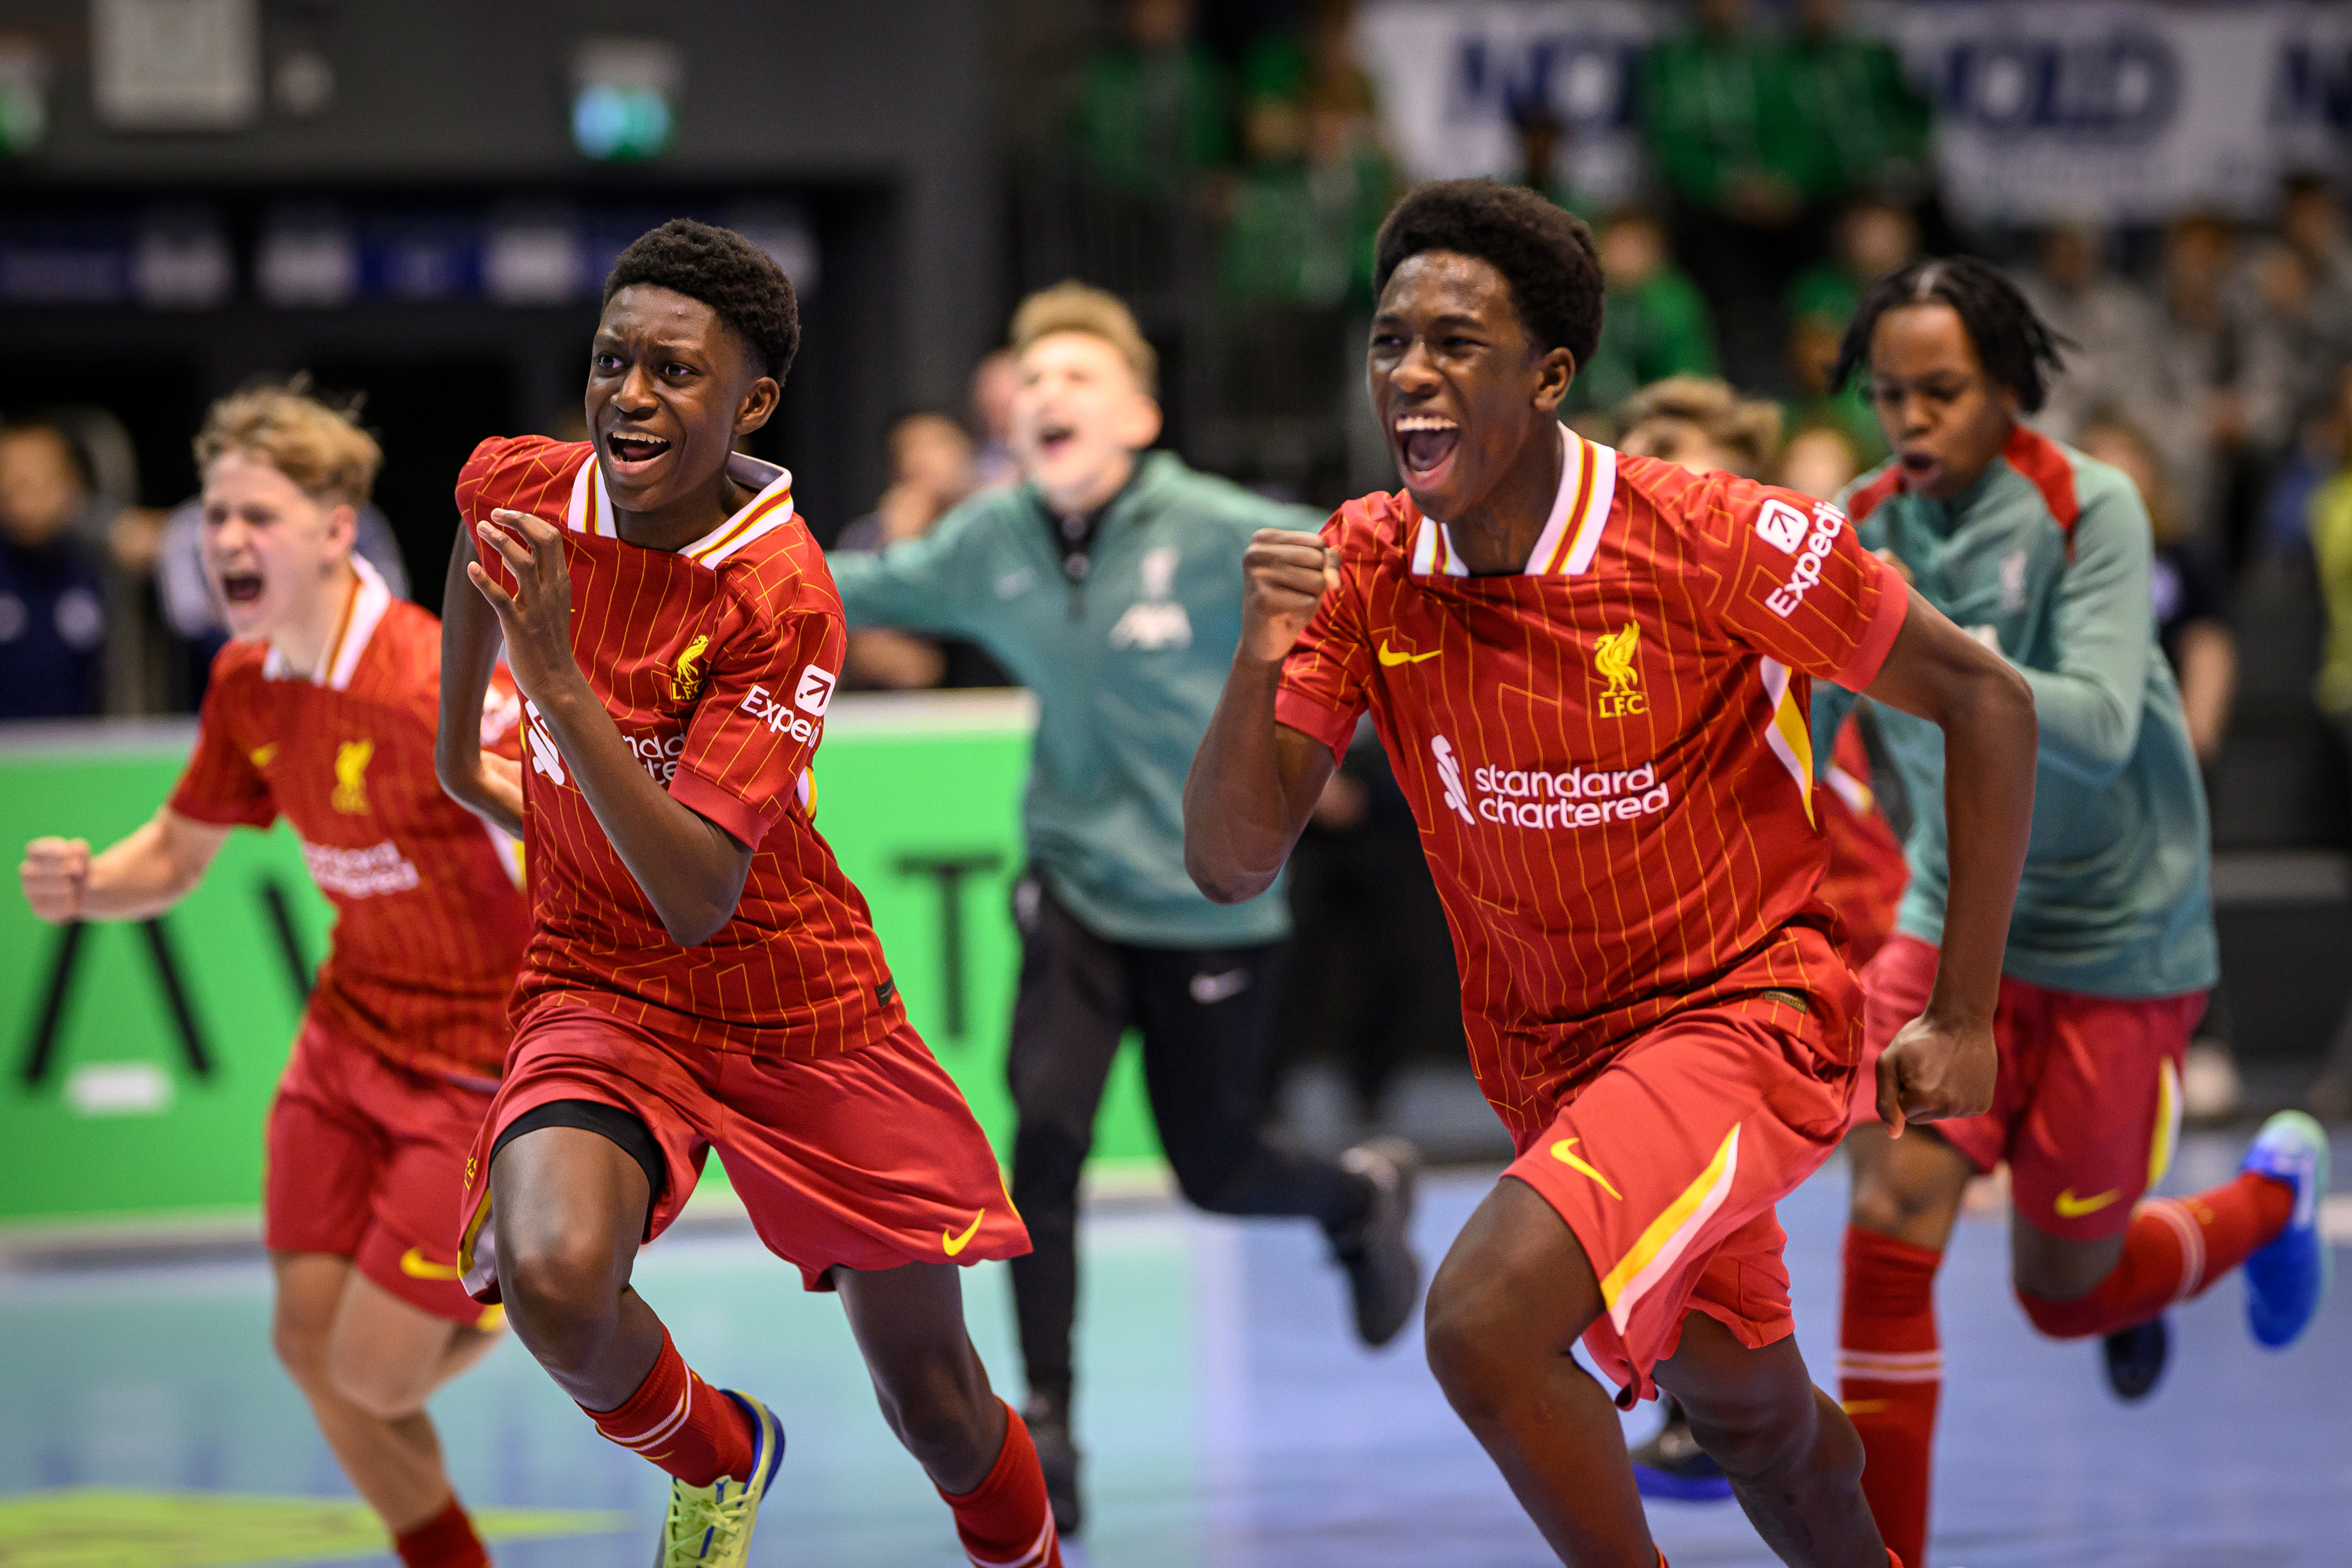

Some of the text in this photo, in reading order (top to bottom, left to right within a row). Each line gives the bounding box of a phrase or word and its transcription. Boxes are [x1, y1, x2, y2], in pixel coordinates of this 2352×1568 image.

[1764, 500, 1846, 619] Expedi
[1474, 761, 1655, 799] standard
[1479, 782, 1670, 829] chartered
